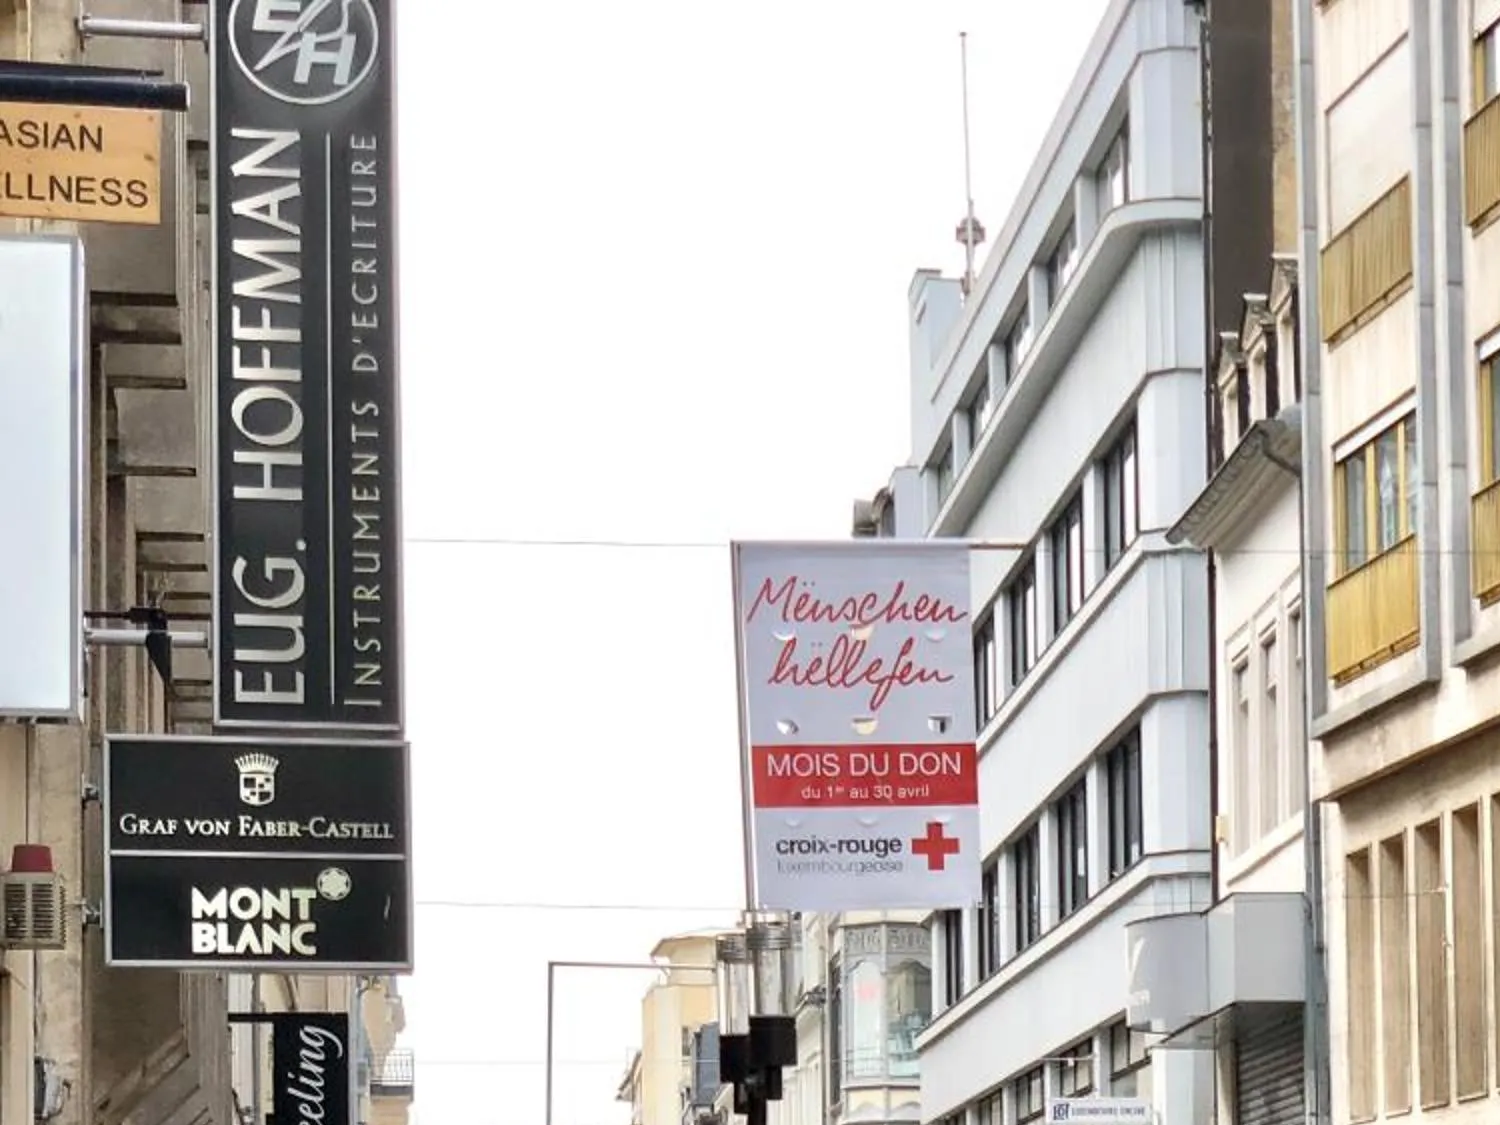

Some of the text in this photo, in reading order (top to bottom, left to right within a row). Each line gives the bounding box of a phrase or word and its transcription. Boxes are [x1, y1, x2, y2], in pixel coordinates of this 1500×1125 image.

[0, 119, 103, 152] ASIAN
[0, 171, 149, 208] LLNESS
[231, 127, 307, 705] EUG. HOFFMAN
[344, 134, 383, 707] INSTRUMENTS D'ECRITURE
[747, 575, 968, 628] Mënschen
[767, 633, 955, 712] hëllefen
[767, 751, 962, 777] MOIS DU DON
[801, 786, 821, 799] du
[850, 787, 869, 798] au
[873, 785, 893, 798] 30
[897, 784, 929, 798] avril
[119, 813, 178, 835] GRAF
[776, 835, 903, 858] croix-rouge
[191, 886, 317, 921] MONT
[191, 922, 317, 955] BLANC
